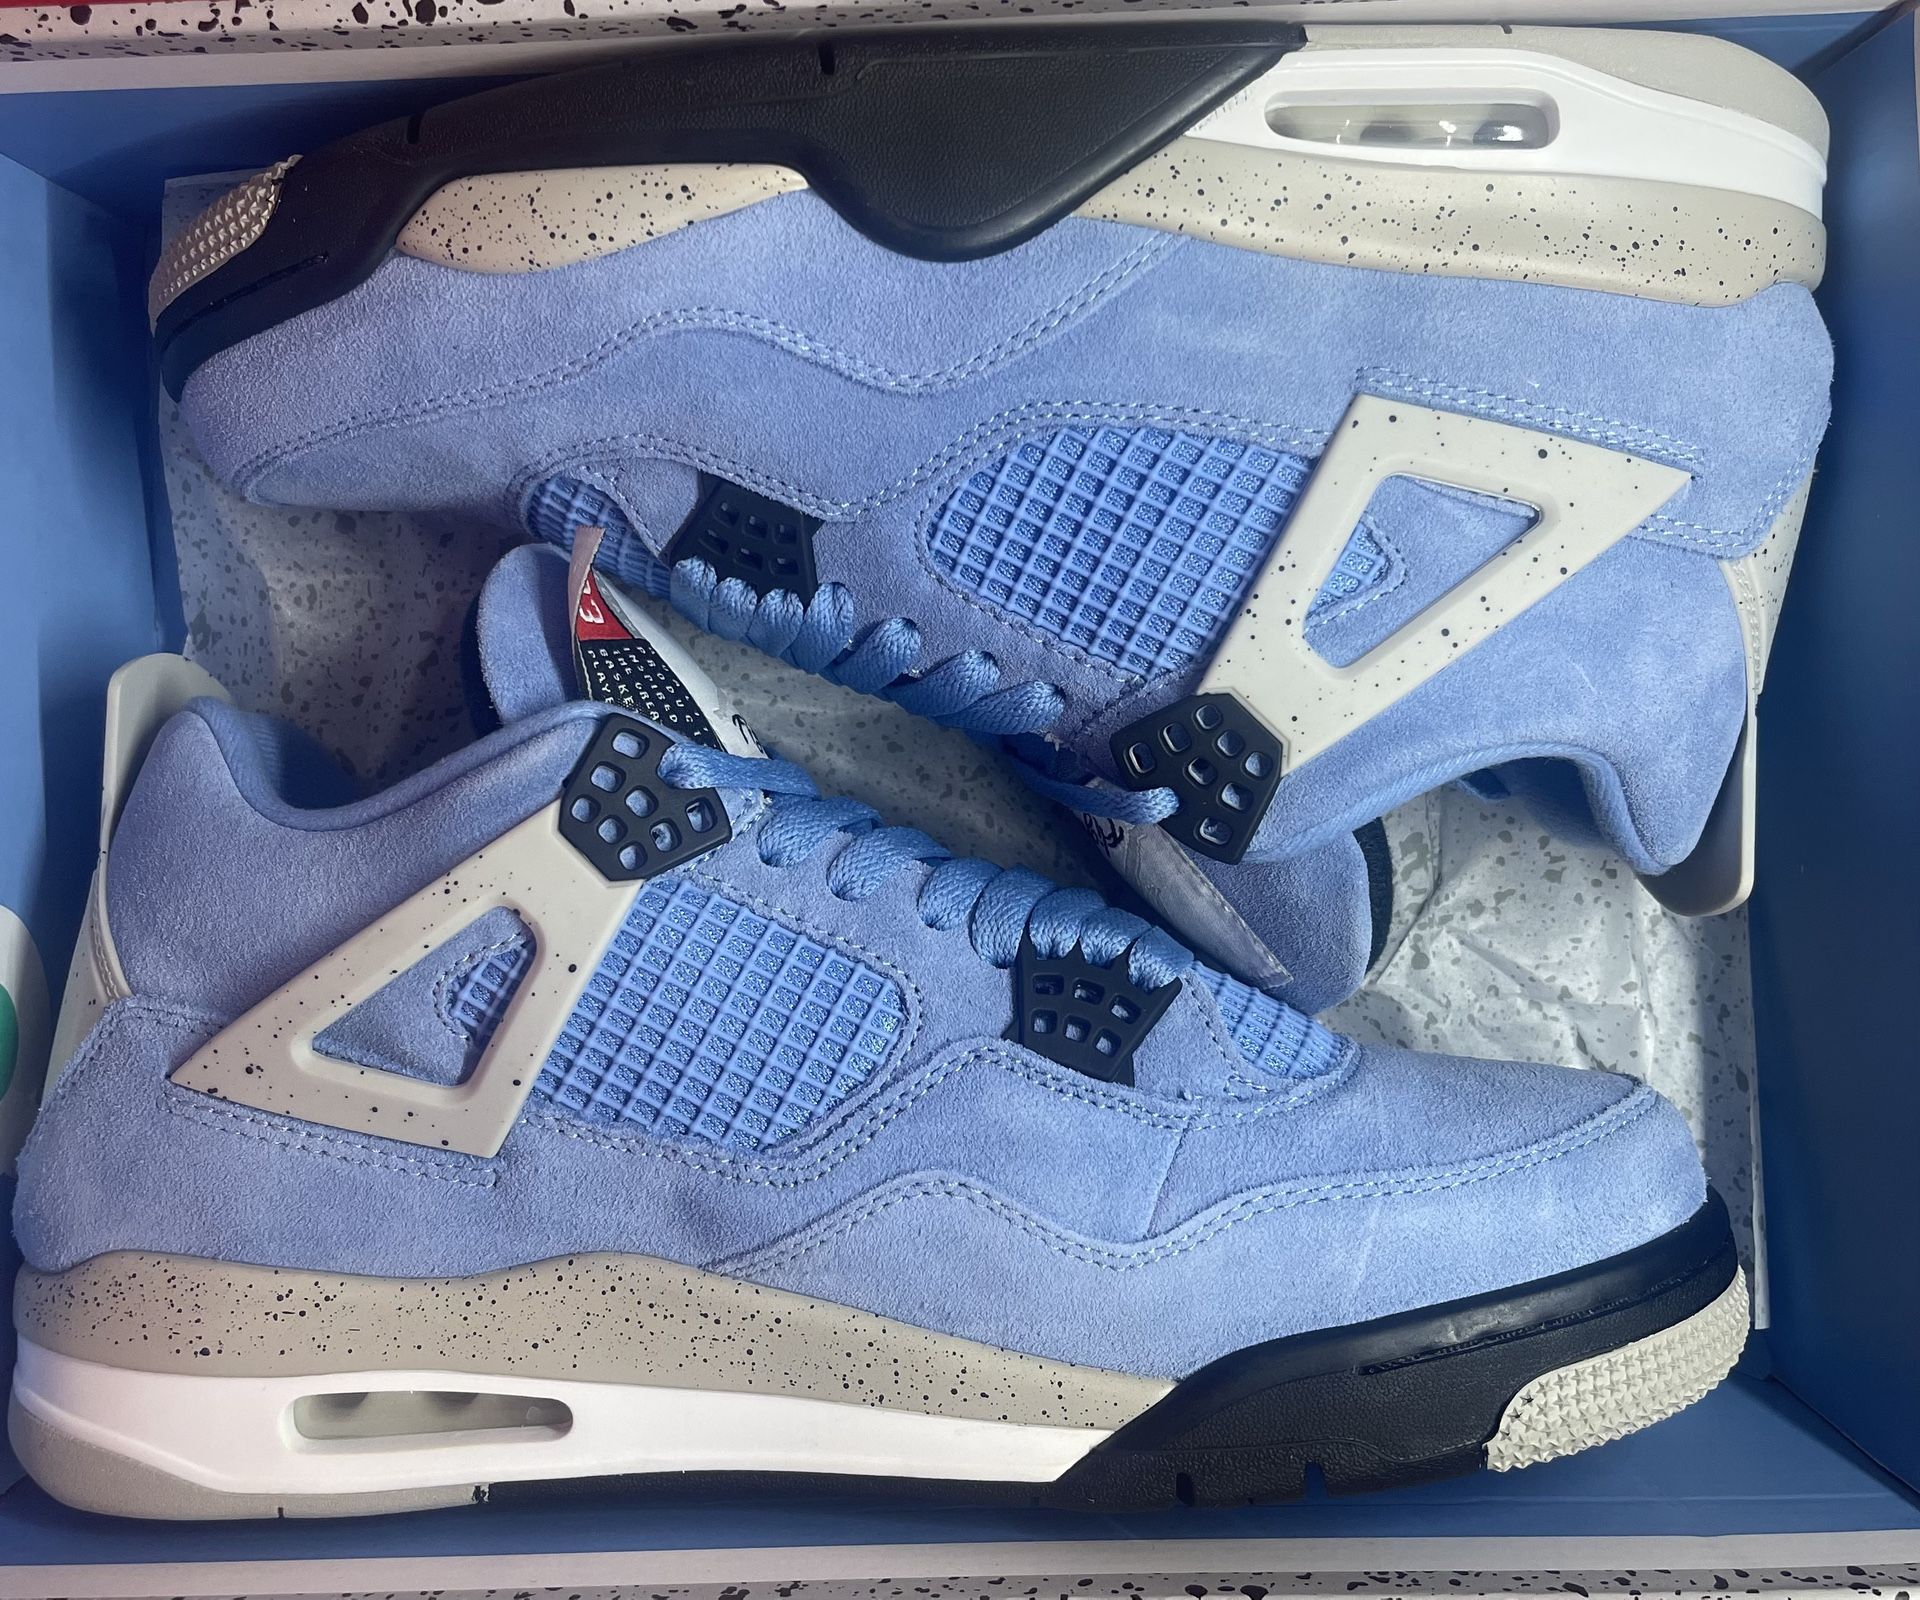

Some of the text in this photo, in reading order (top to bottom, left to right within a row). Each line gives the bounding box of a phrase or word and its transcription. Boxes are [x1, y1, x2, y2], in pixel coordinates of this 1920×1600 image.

[587, 650, 615, 704] PLAYE
[599, 648, 639, 713] BASKE
[613, 649, 634, 675] THE
[635, 681, 660, 721] GREA
[623, 647, 678, 723] INSPIRED
